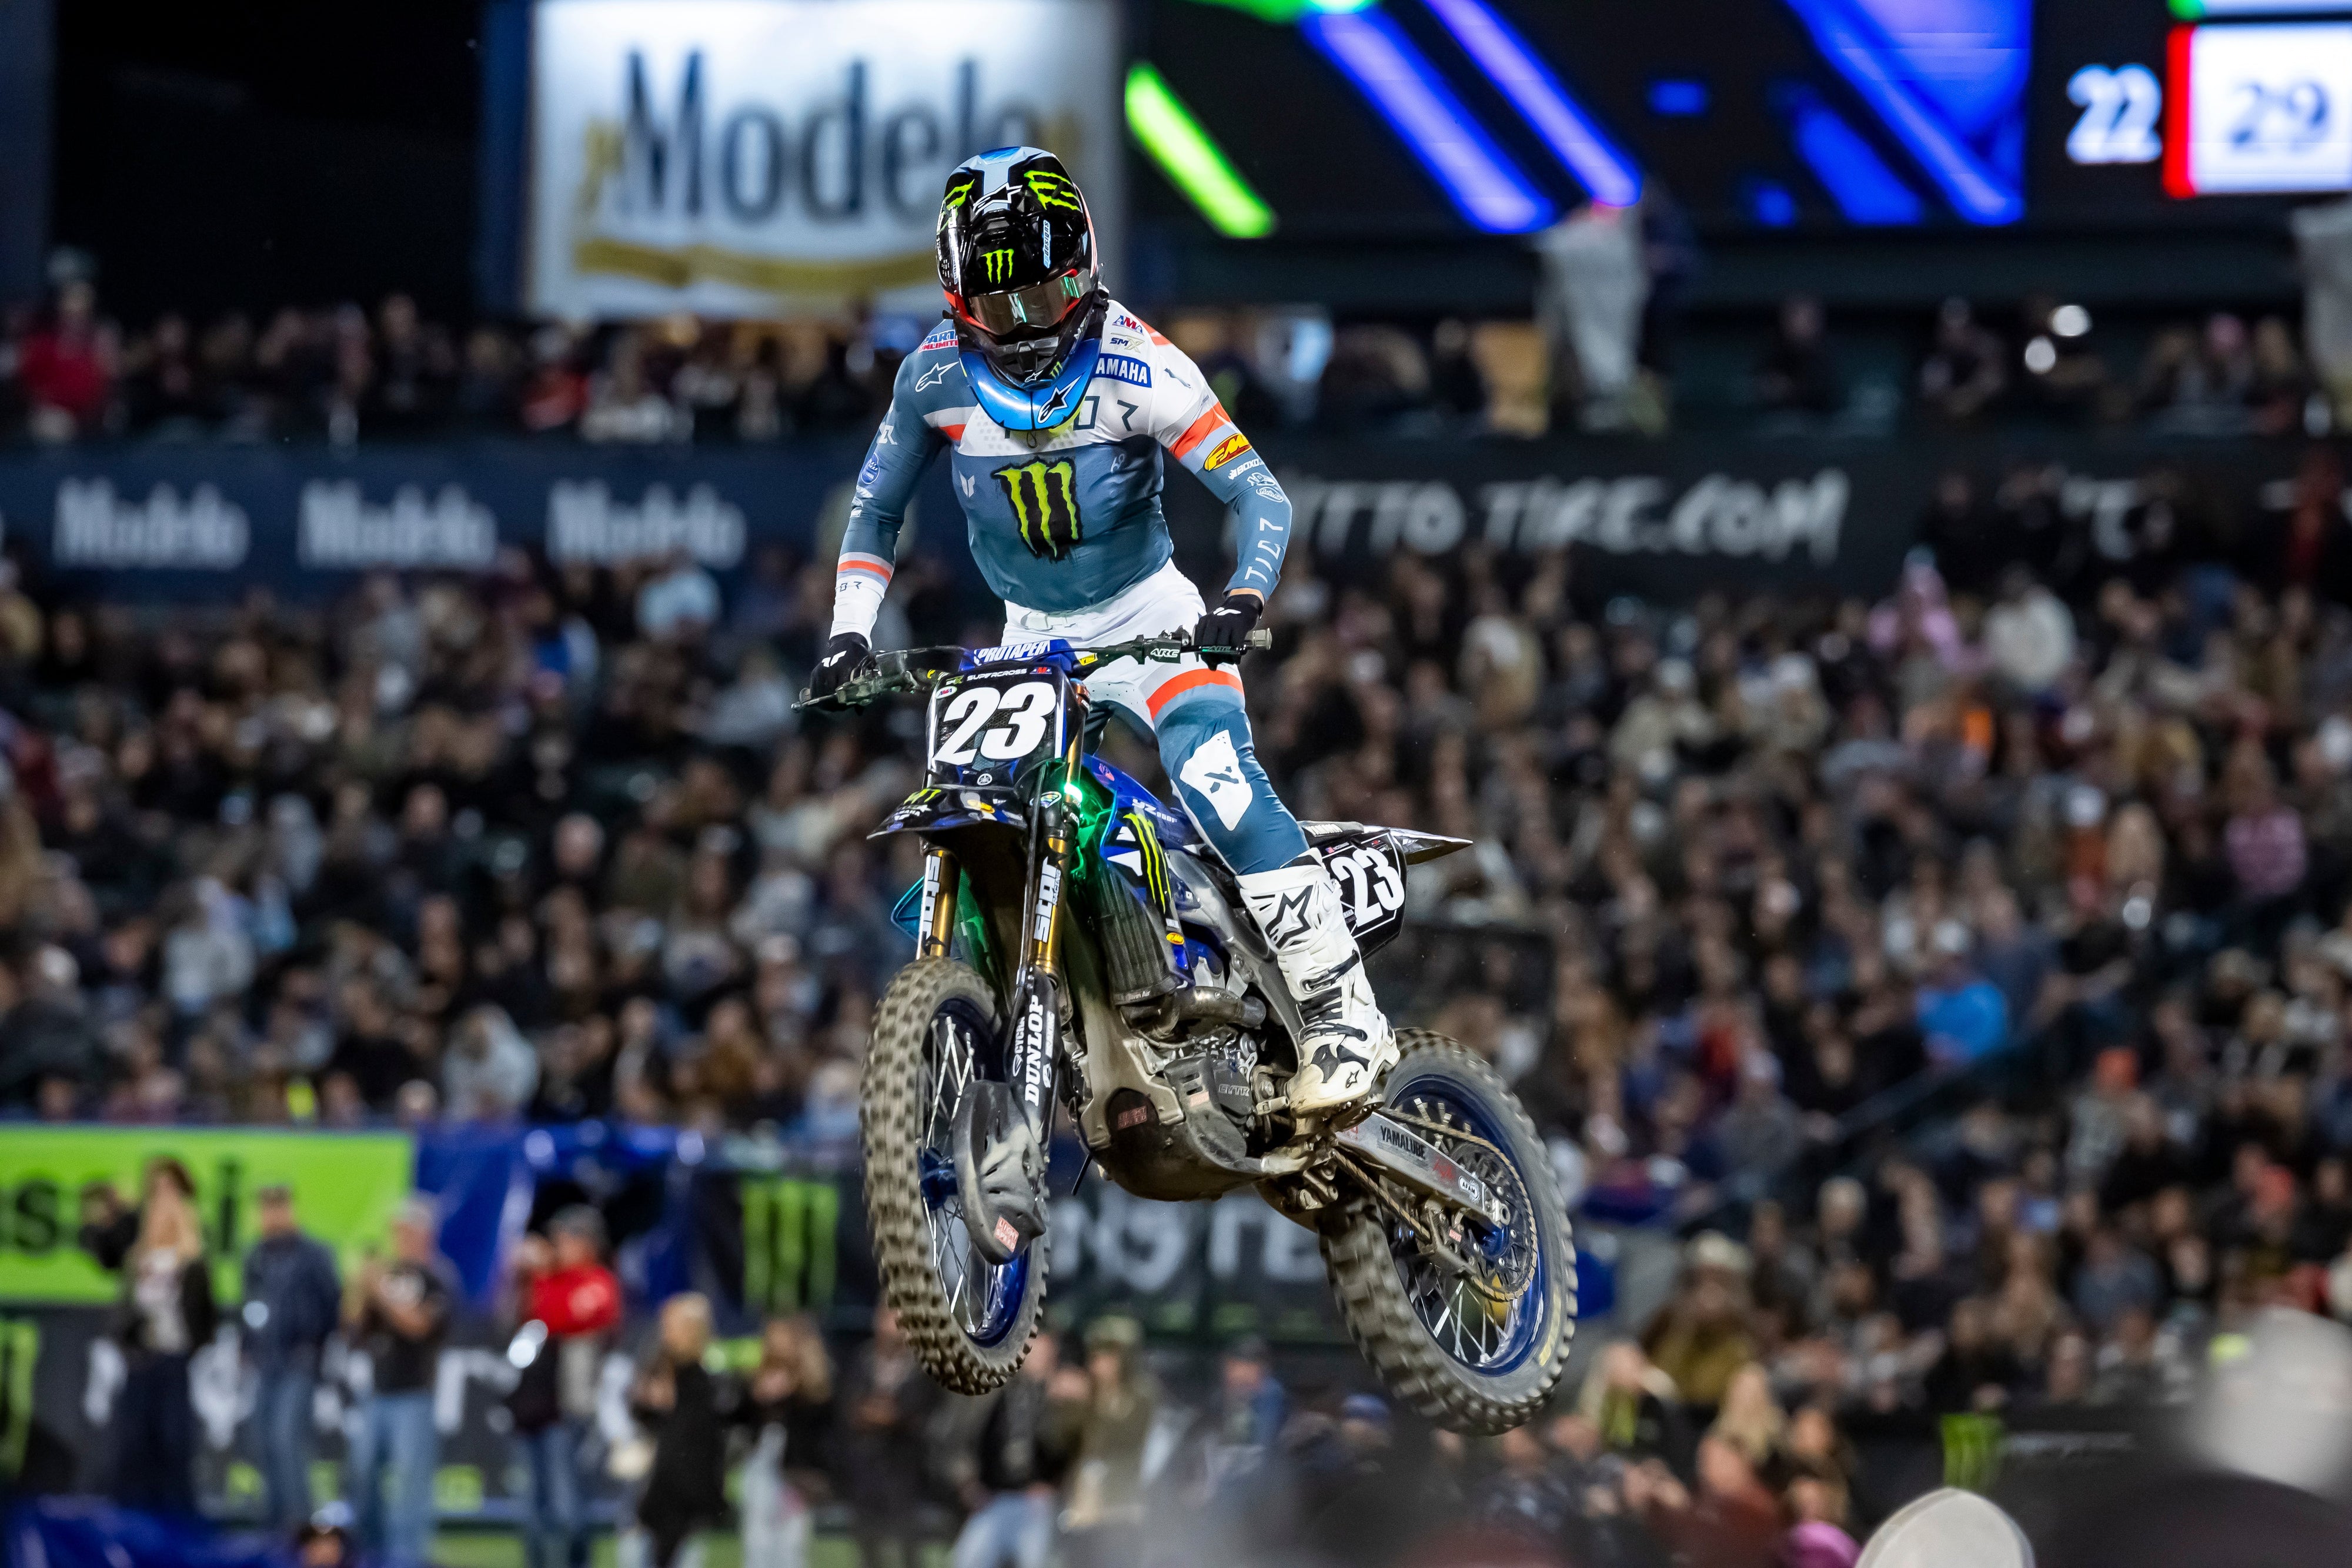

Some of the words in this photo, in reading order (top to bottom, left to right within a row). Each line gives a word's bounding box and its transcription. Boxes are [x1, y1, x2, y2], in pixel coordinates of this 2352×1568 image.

[2065, 63, 2163, 165] 22
[921, 329, 958, 347] PART
[1111, 314, 1144, 336] AMA
[1095, 357, 1148, 384] AMAHA
[977, 640, 1047, 663] PROTAPER
[1150, 648, 1180, 657] ARC
[967, 668, 1028, 681] SUPERCROSS
[934, 681, 1057, 765] 23
[1330, 847, 1405, 928] 23
[1025, 995, 1043, 1107] DUNLOP
[1379, 1125, 1426, 1161] YAMALUBE
